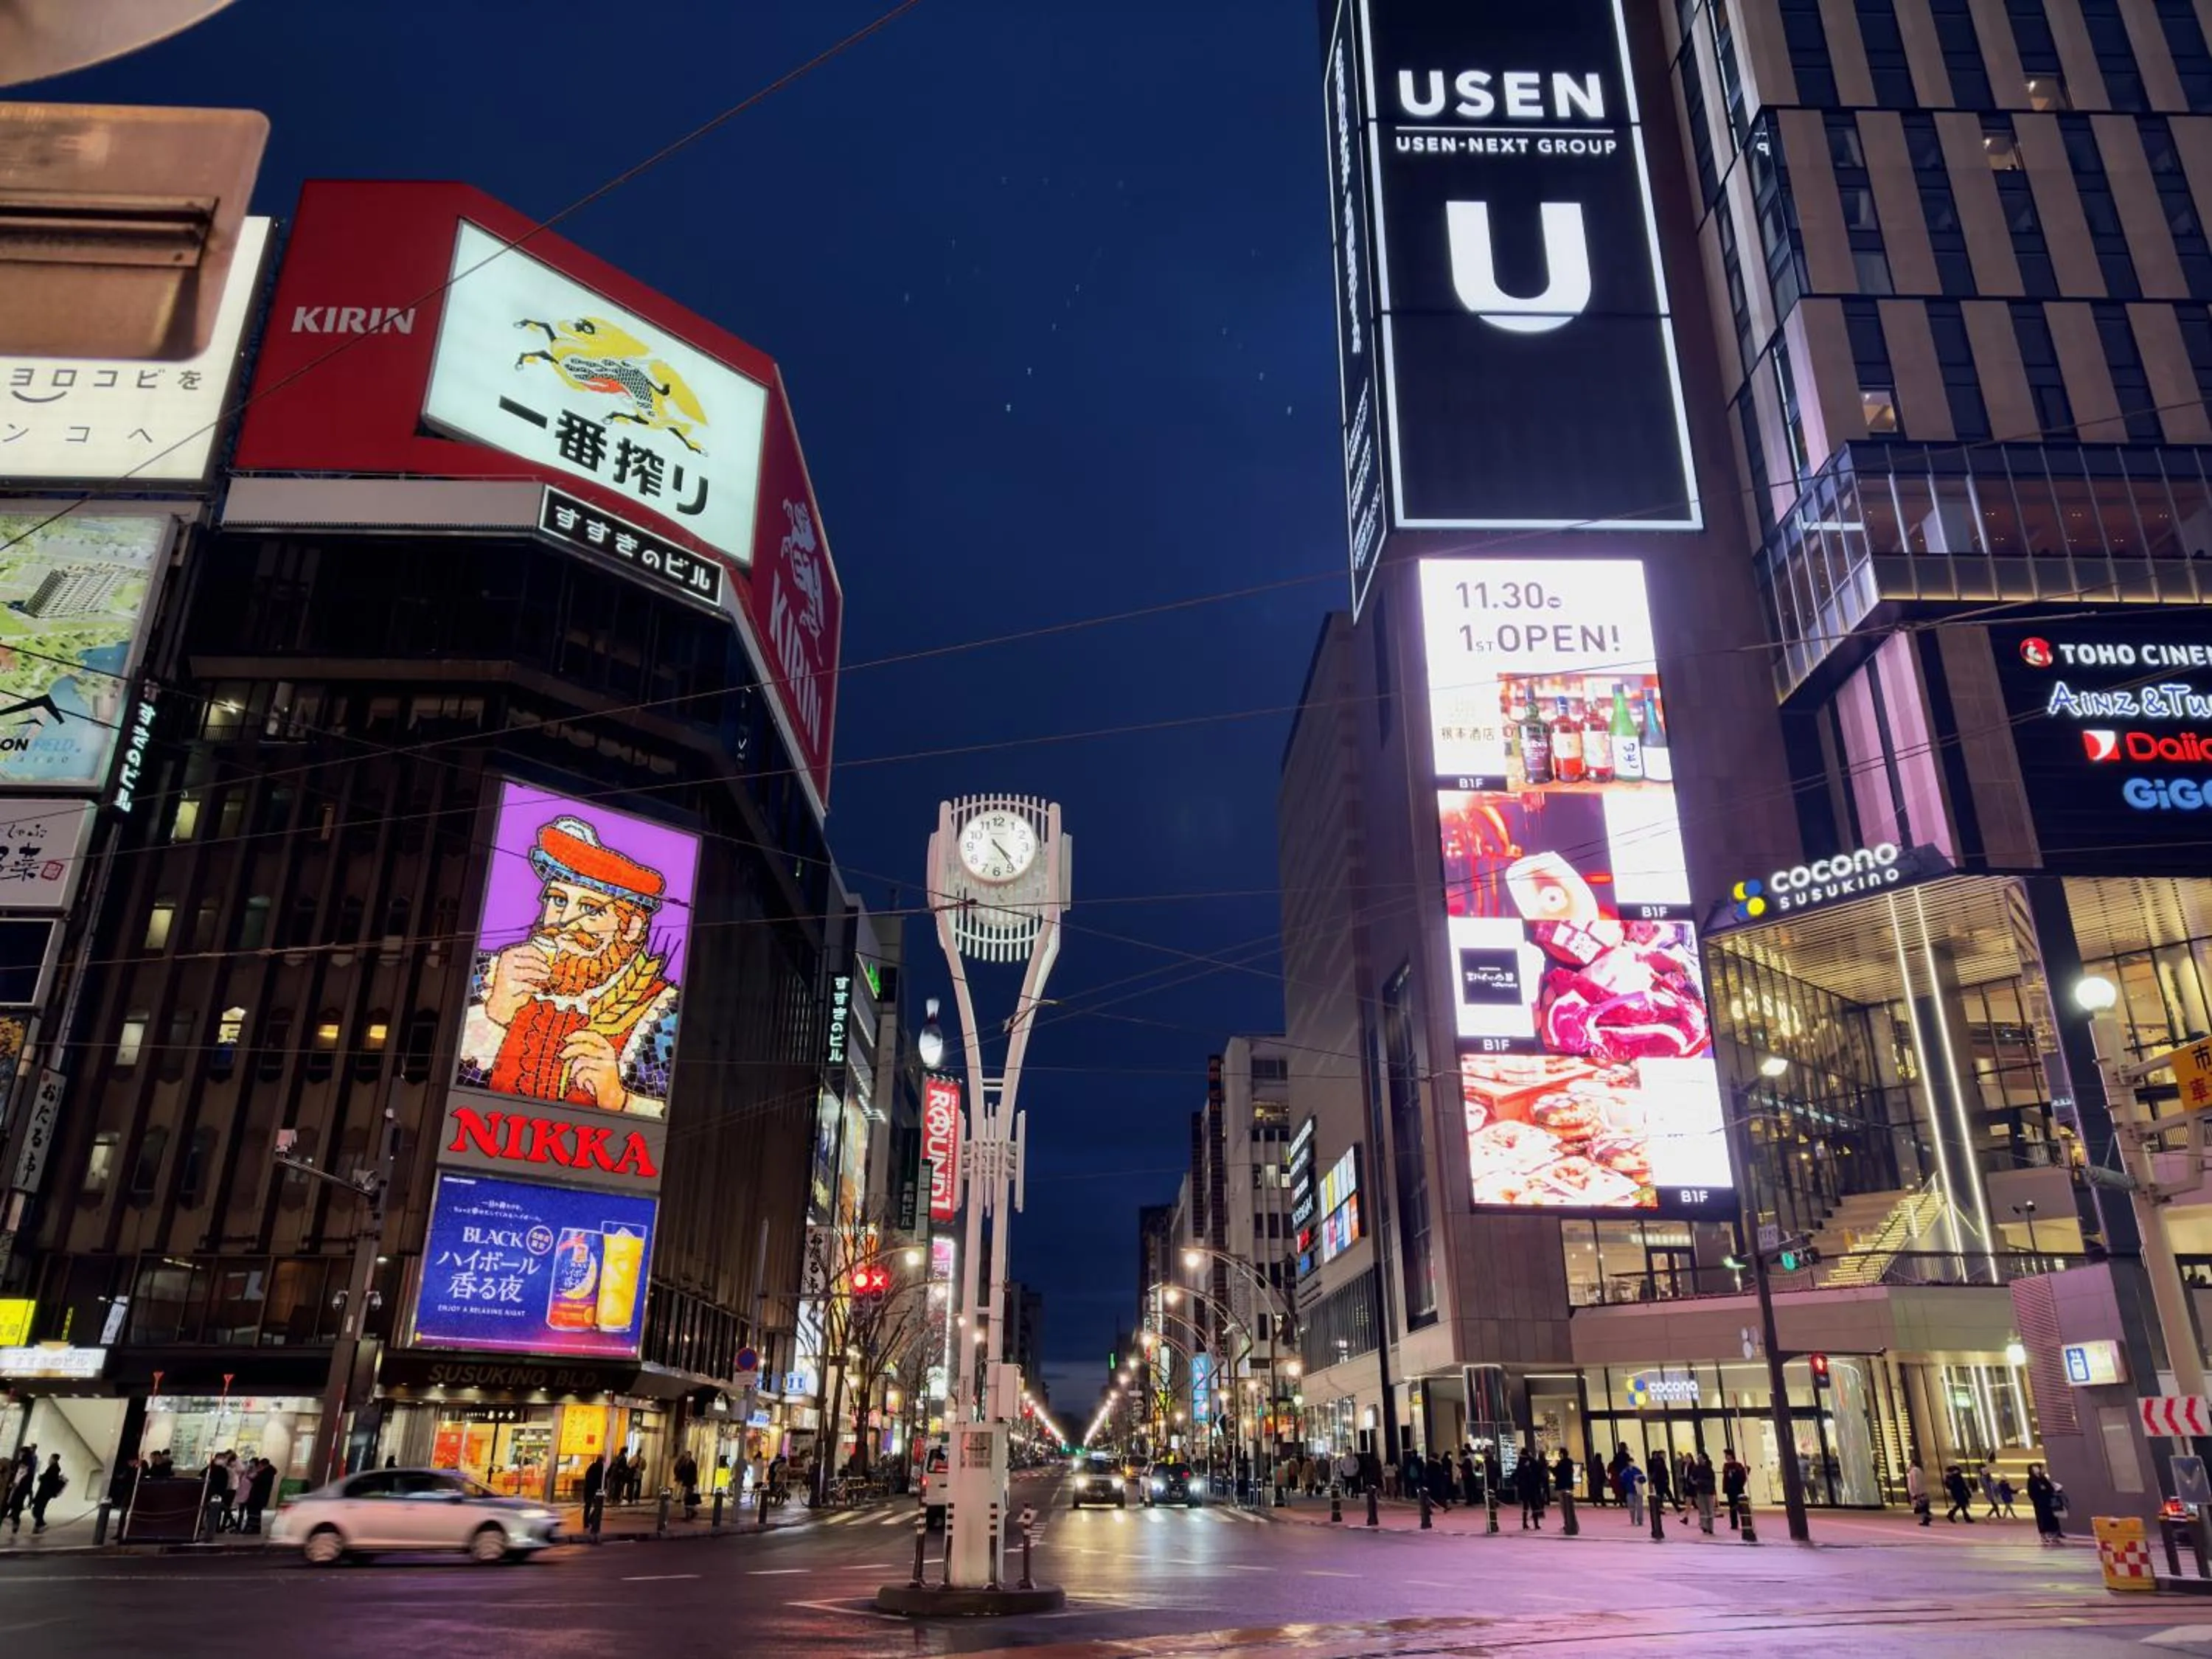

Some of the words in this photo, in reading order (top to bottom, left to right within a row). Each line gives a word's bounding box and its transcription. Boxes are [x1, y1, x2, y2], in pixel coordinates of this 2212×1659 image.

[1398, 70, 1606, 119] USEN
[1396, 136, 1529, 153] USEN-NEXT
[1537, 139, 1618, 155] GROUP
[1446, 200, 1593, 333] U
[291, 306, 416, 334] KIRIN
[10, 366, 202, 391] ヨロコビを
[498, 394, 709, 516] 一番搾り
[554, 505, 711, 591] すすきのビル
[1455, 582, 1545, 609] 11.30
[1497, 625, 1621, 653] OPEN!
[769, 567, 821, 756] KIRIN
[2059, 644, 2136, 664] TOHO
[2140, 644, 2212, 666] CINE
[1458, 776, 1484, 790] B1F
[981, 821, 990, 830] 11
[992, 815, 1005, 827] 12
[970, 830, 982, 840] 10
[992, 866, 1001, 877] 6
[1770, 843, 1898, 893] cocono
[1642, 905, 1668, 919] B1F
[828, 977, 850, 1062] すすきのビル
[1483, 1038, 1510, 1051] B1F
[448, 1107, 658, 1178] NIKKA
[926, 1088, 951, 1210] ROUND1
[1680, 1190, 1708, 1203] B1F
[462, 1226, 524, 1248] BLACK
[437, 1250, 542, 1275] ハイボール
[446, 1271, 525, 1304] 香る夜
[428, 1363, 547, 1385] SUSUKINO
[1649, 1380, 1699, 1393] cocono
